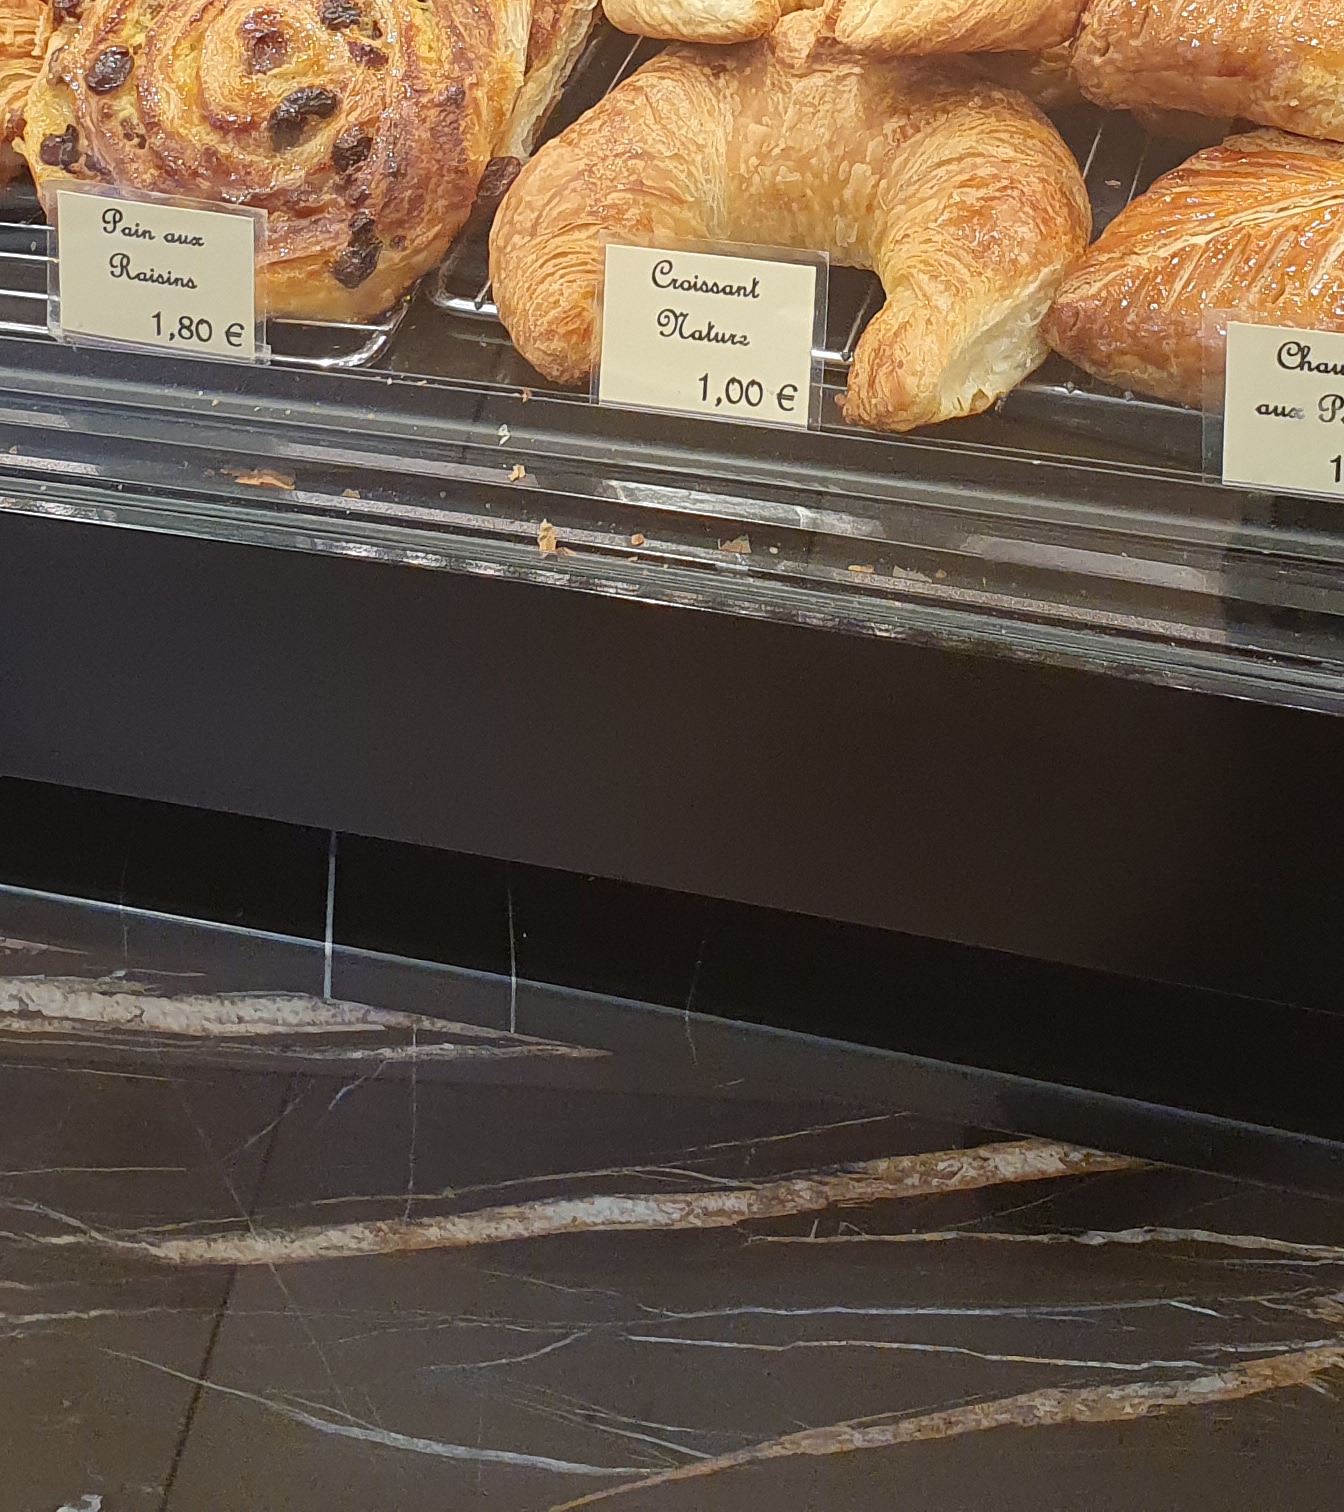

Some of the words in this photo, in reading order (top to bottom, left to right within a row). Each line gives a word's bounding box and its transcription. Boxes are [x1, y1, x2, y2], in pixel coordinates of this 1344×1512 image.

[102, 208, 155, 241] Pain
[163, 230, 205, 247] aux
[109, 253, 197, 289] Raisins
[652, 259, 760, 299] Croissant
[151, 311, 212, 343] 1,80
[225, 323, 245, 347] €
[657, 308, 750, 347] Nature
[698, 373, 763, 407] 1,00
[777, 384, 798, 411] €
[1255, 402, 1305, 419] aux
